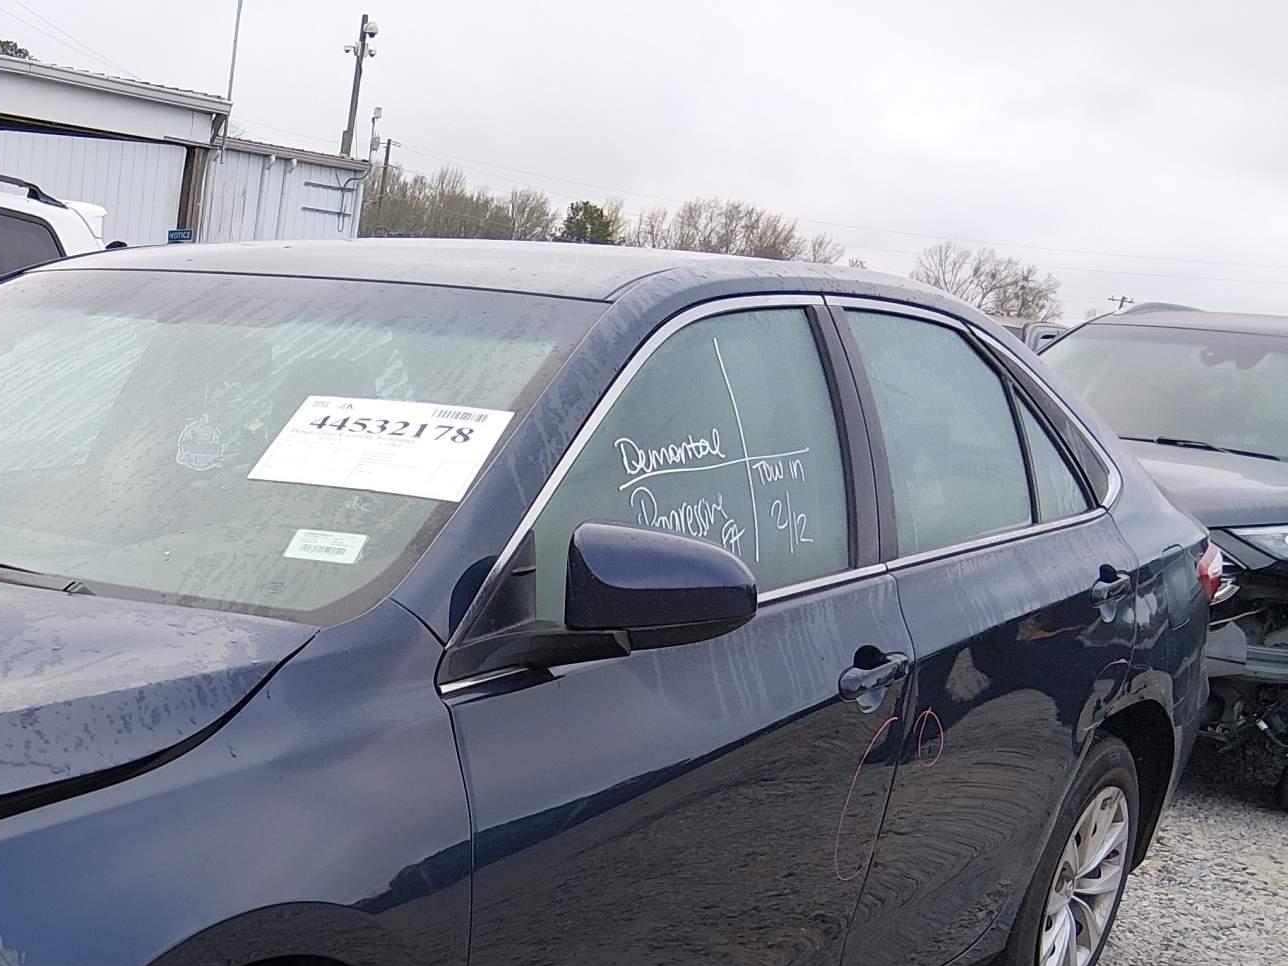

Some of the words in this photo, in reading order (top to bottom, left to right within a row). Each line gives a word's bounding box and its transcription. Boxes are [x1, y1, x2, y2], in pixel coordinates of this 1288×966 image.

[169, 231, 191, 239] NOTICE
[309, 415, 475, 444] 44532178
[770, 490, 814, 555] 2/12
